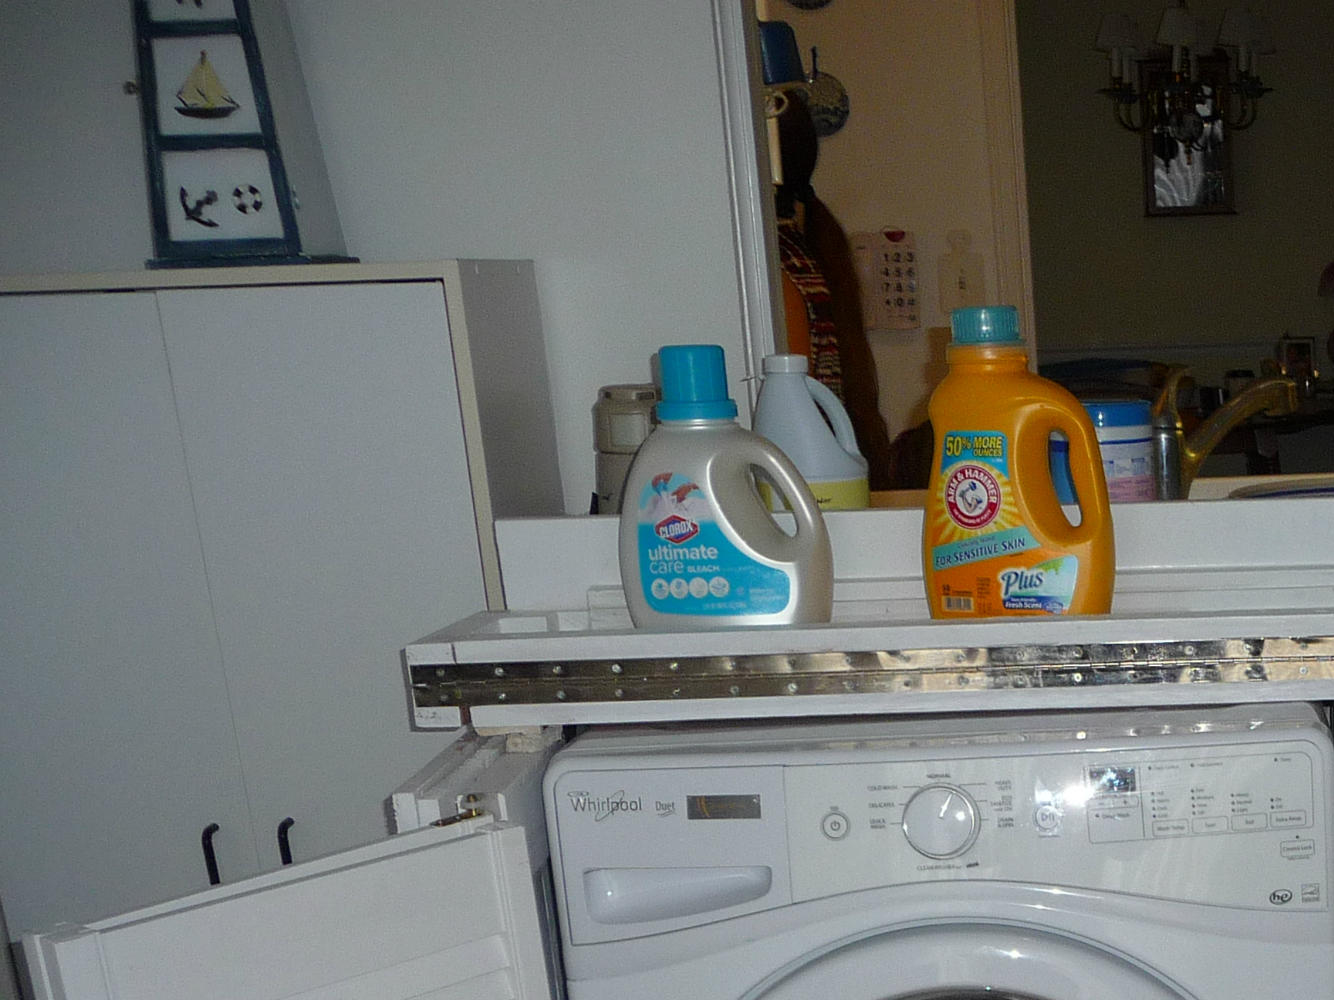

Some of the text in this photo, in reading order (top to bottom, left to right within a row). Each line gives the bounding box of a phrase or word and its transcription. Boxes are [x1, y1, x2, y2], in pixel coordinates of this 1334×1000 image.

[946, 436, 1003, 457] 50% MORE
[973, 448, 1003, 457] OUNCES
[948, 468, 998, 503] ARM & HAMMER
[659, 520, 694, 538] CLOROX
[648, 544, 719, 560] ultimate
[935, 554, 952, 566] FOR
[953, 544, 999, 562] SENSITIVE
[1001, 538, 1026, 552] SKIN
[649, 560, 720, 574] care BLEACH
[1001, 570, 1044, 597] Plus
[1005, 601, 1024, 609] Fresh
[1024, 601, 1042, 609] Scent
[569, 793, 675, 817] Whirlpool Duet
[1271, 890, 1291, 903] he
